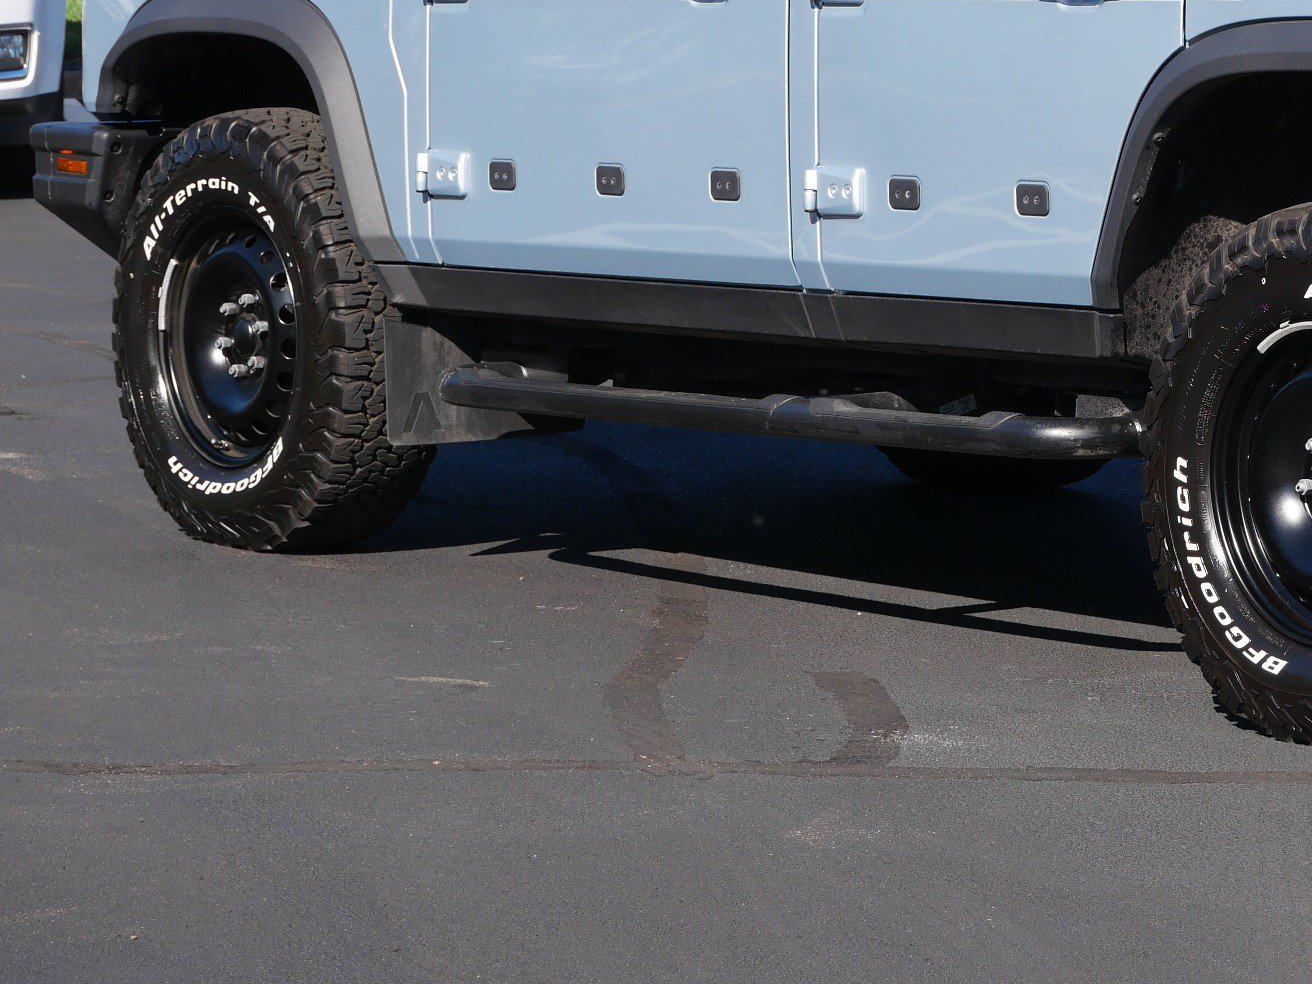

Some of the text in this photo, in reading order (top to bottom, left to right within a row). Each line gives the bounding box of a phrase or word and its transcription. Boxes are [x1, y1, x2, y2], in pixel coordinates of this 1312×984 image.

[143, 176, 240, 262] All-Terrain
[248, 191, 275, 233] T/A
[167, 436, 284, 496] BFGoodrich
[1173, 455, 1289, 676] BFGoodrich
